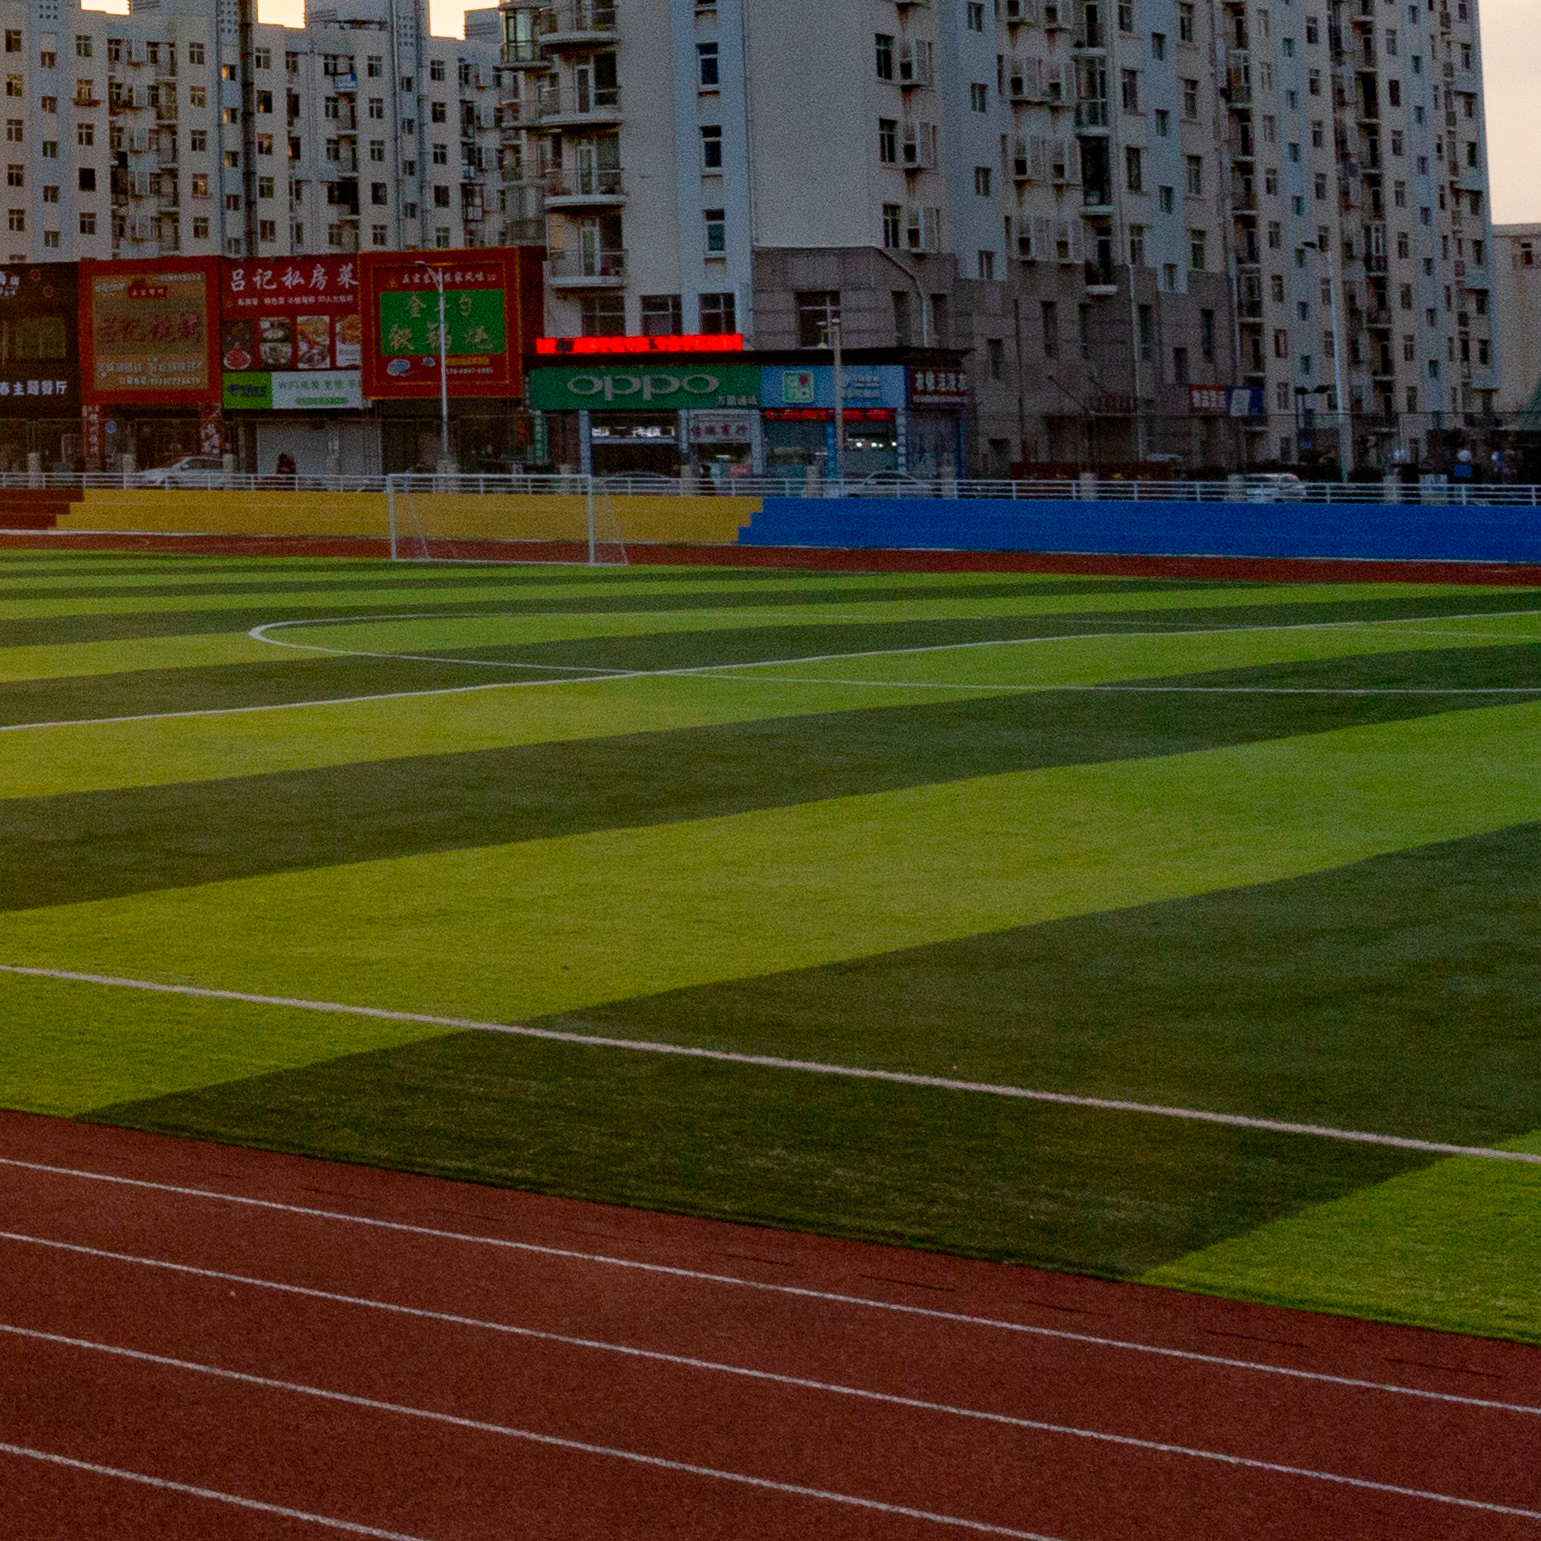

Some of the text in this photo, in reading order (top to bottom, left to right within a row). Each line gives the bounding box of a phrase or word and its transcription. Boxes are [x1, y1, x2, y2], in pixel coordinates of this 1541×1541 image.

[230, 262, 359, 292] 吕记私房菜
